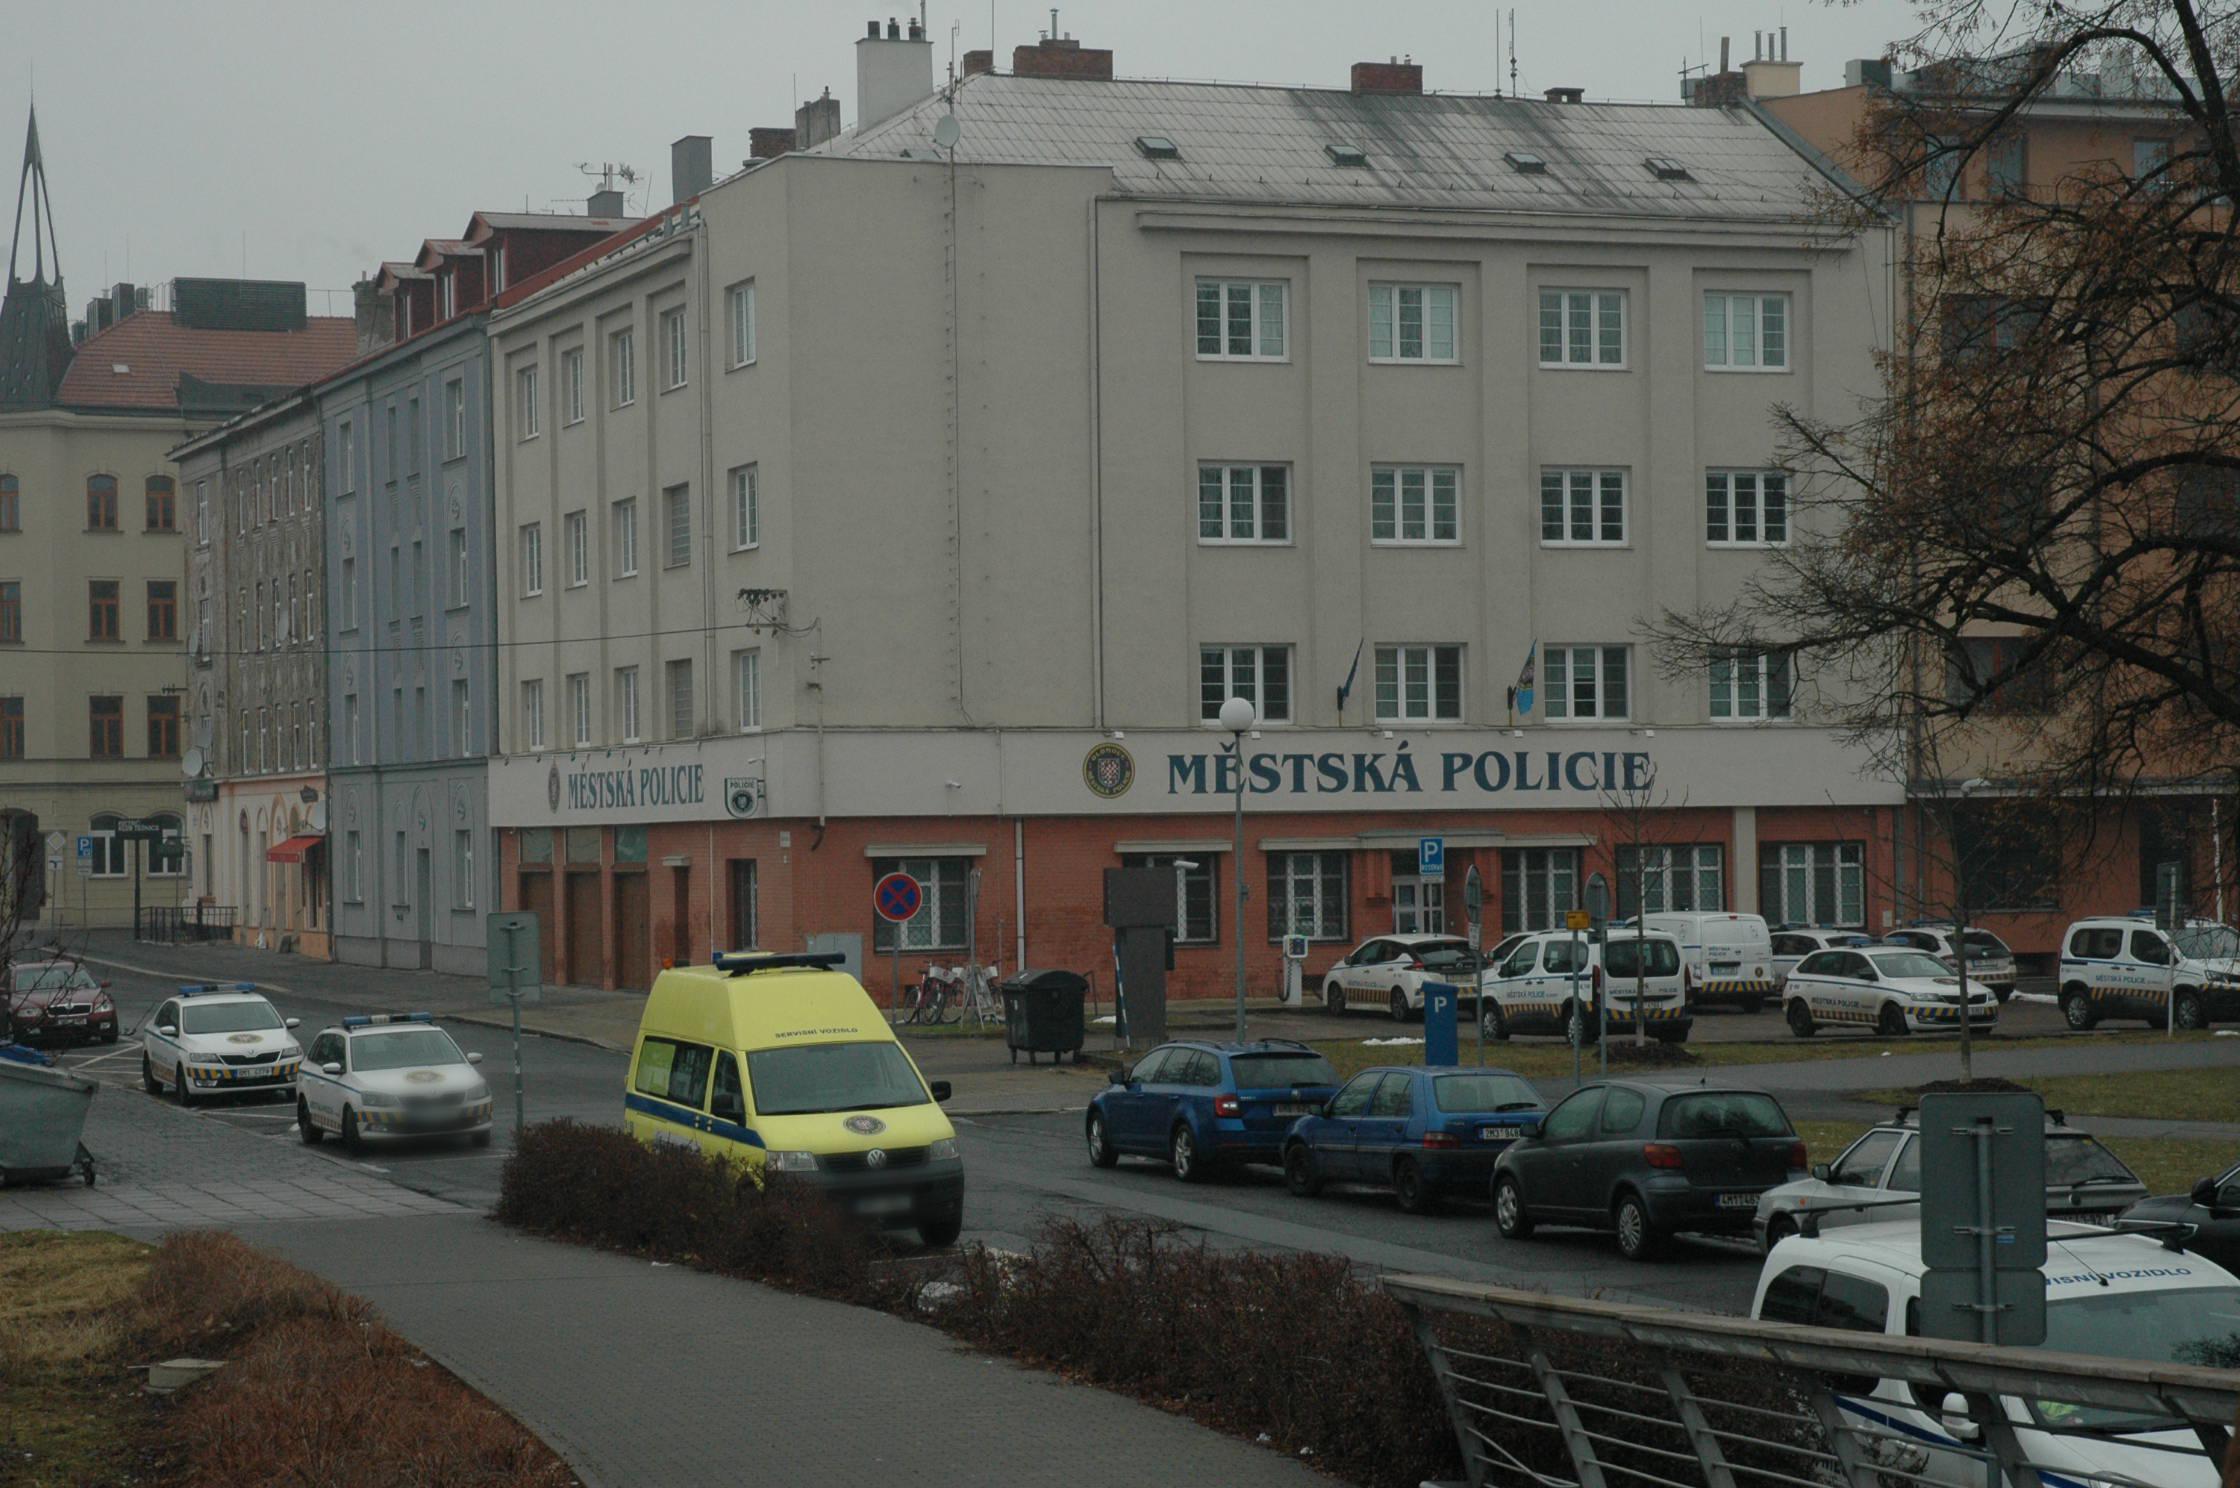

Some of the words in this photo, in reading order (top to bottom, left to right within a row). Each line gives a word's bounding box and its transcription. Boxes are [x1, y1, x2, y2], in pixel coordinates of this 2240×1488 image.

[1166, 739, 1422, 795] MĚSTSKÁ
[1440, 750, 1654, 794] POLICIE
[568, 758, 635, 810] MĚSTSKÁ
[640, 763, 704, 807] POLICIE
[729, 780, 755, 789] POLICIE
[1424, 841, 1438, 863] P
[2123, 976, 2145, 984] POLICIE
[1434, 996, 1447, 1013] P
[776, 1028, 817, 1038] SERVISNÍ
[820, 1027, 858, 1035] VOZIDLO
[2105, 1268, 2192, 1280] VOZIDLO
